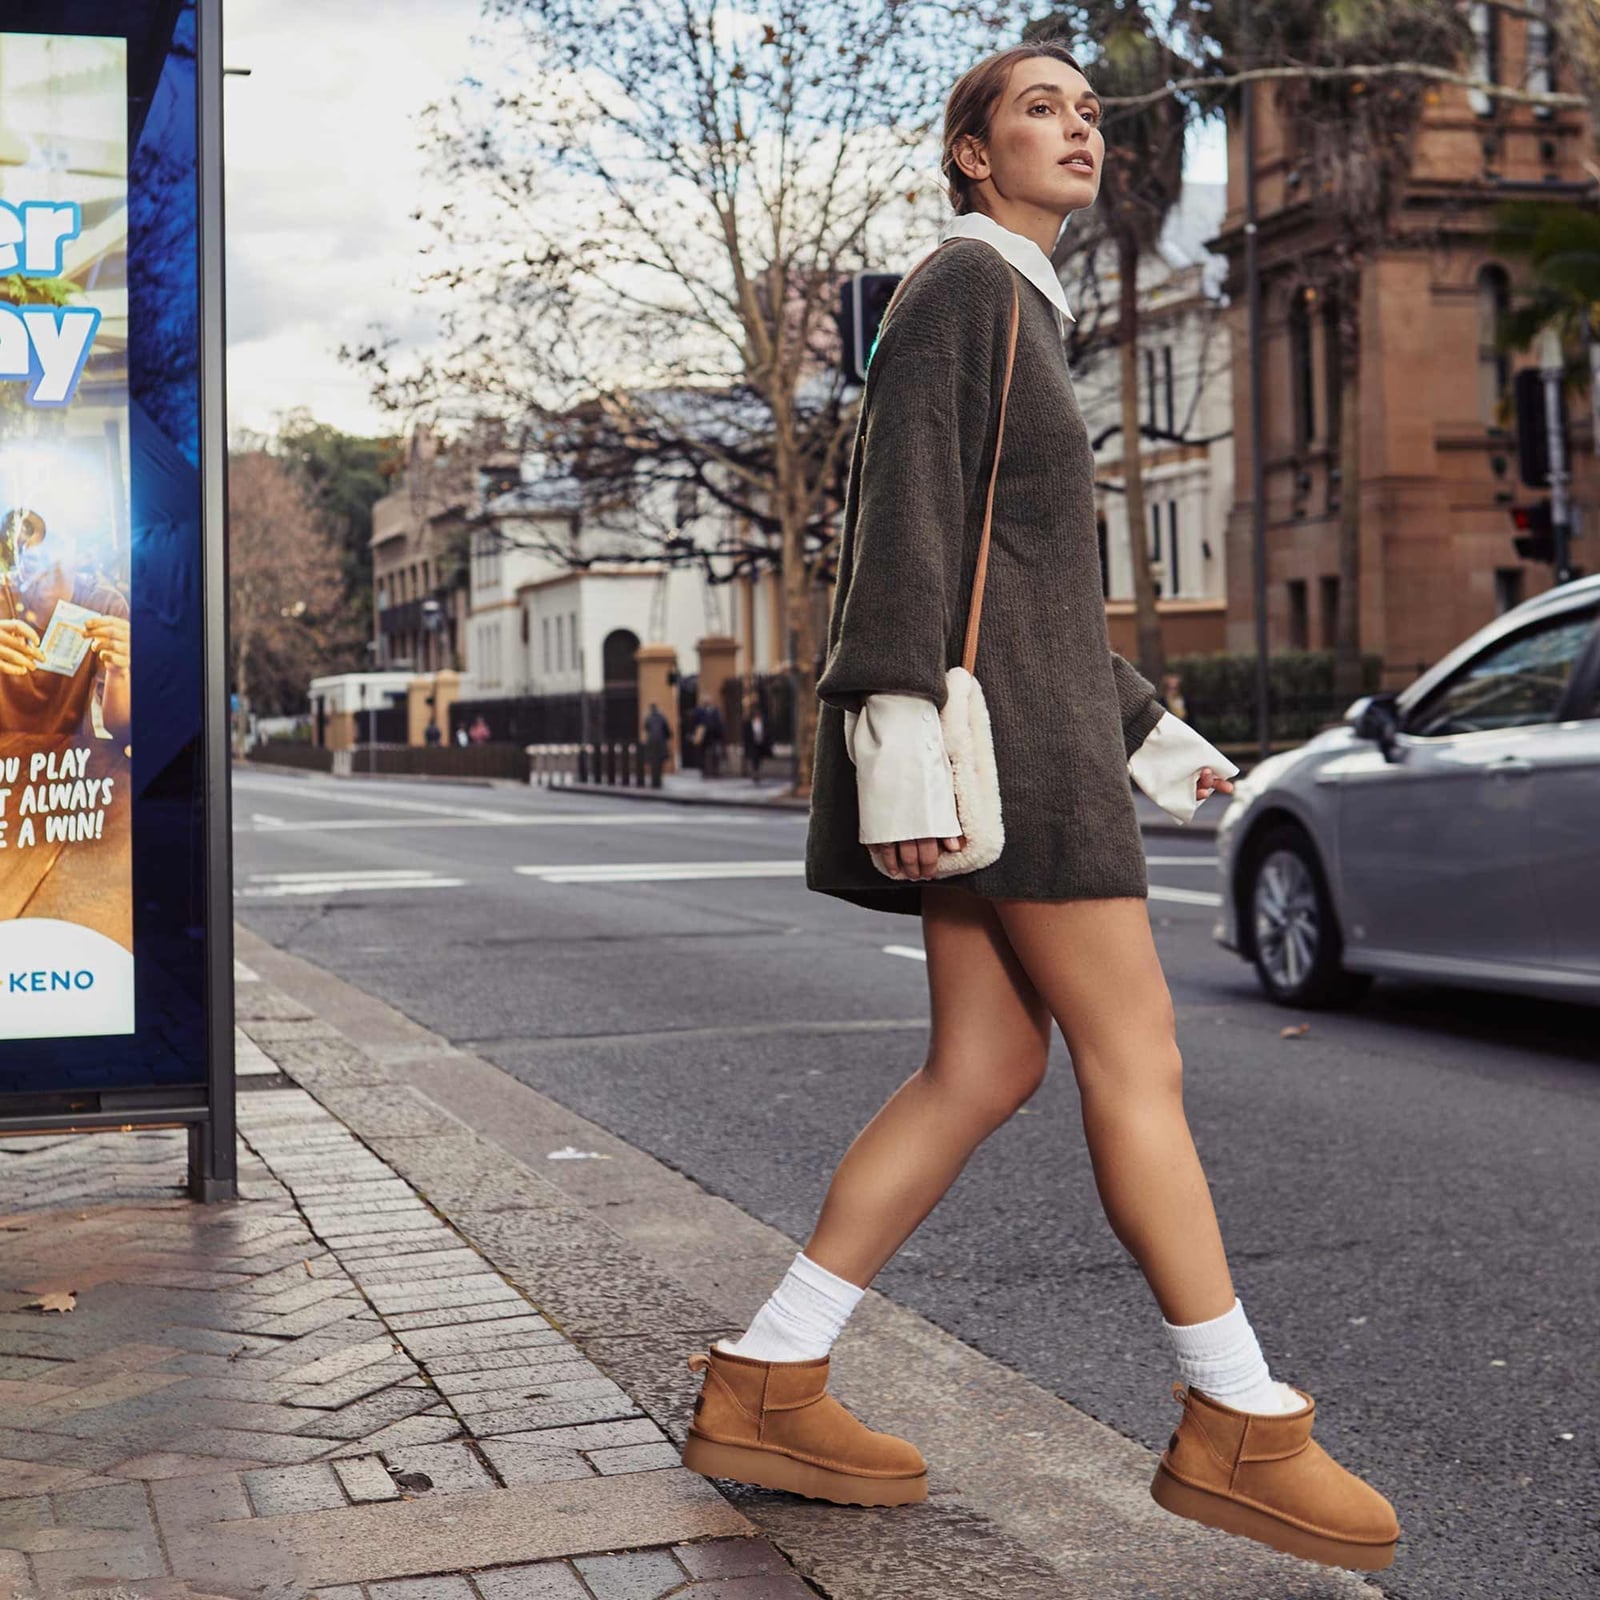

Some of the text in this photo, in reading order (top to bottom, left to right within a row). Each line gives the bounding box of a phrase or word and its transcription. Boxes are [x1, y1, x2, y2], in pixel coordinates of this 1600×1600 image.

[30, 748, 91, 782] PLAY
[19, 777, 114, 816] ALWAYS
[17, 817, 36, 849] A
[45, 809, 105, 843] WIN!
[9, 970, 94, 993] KENO
